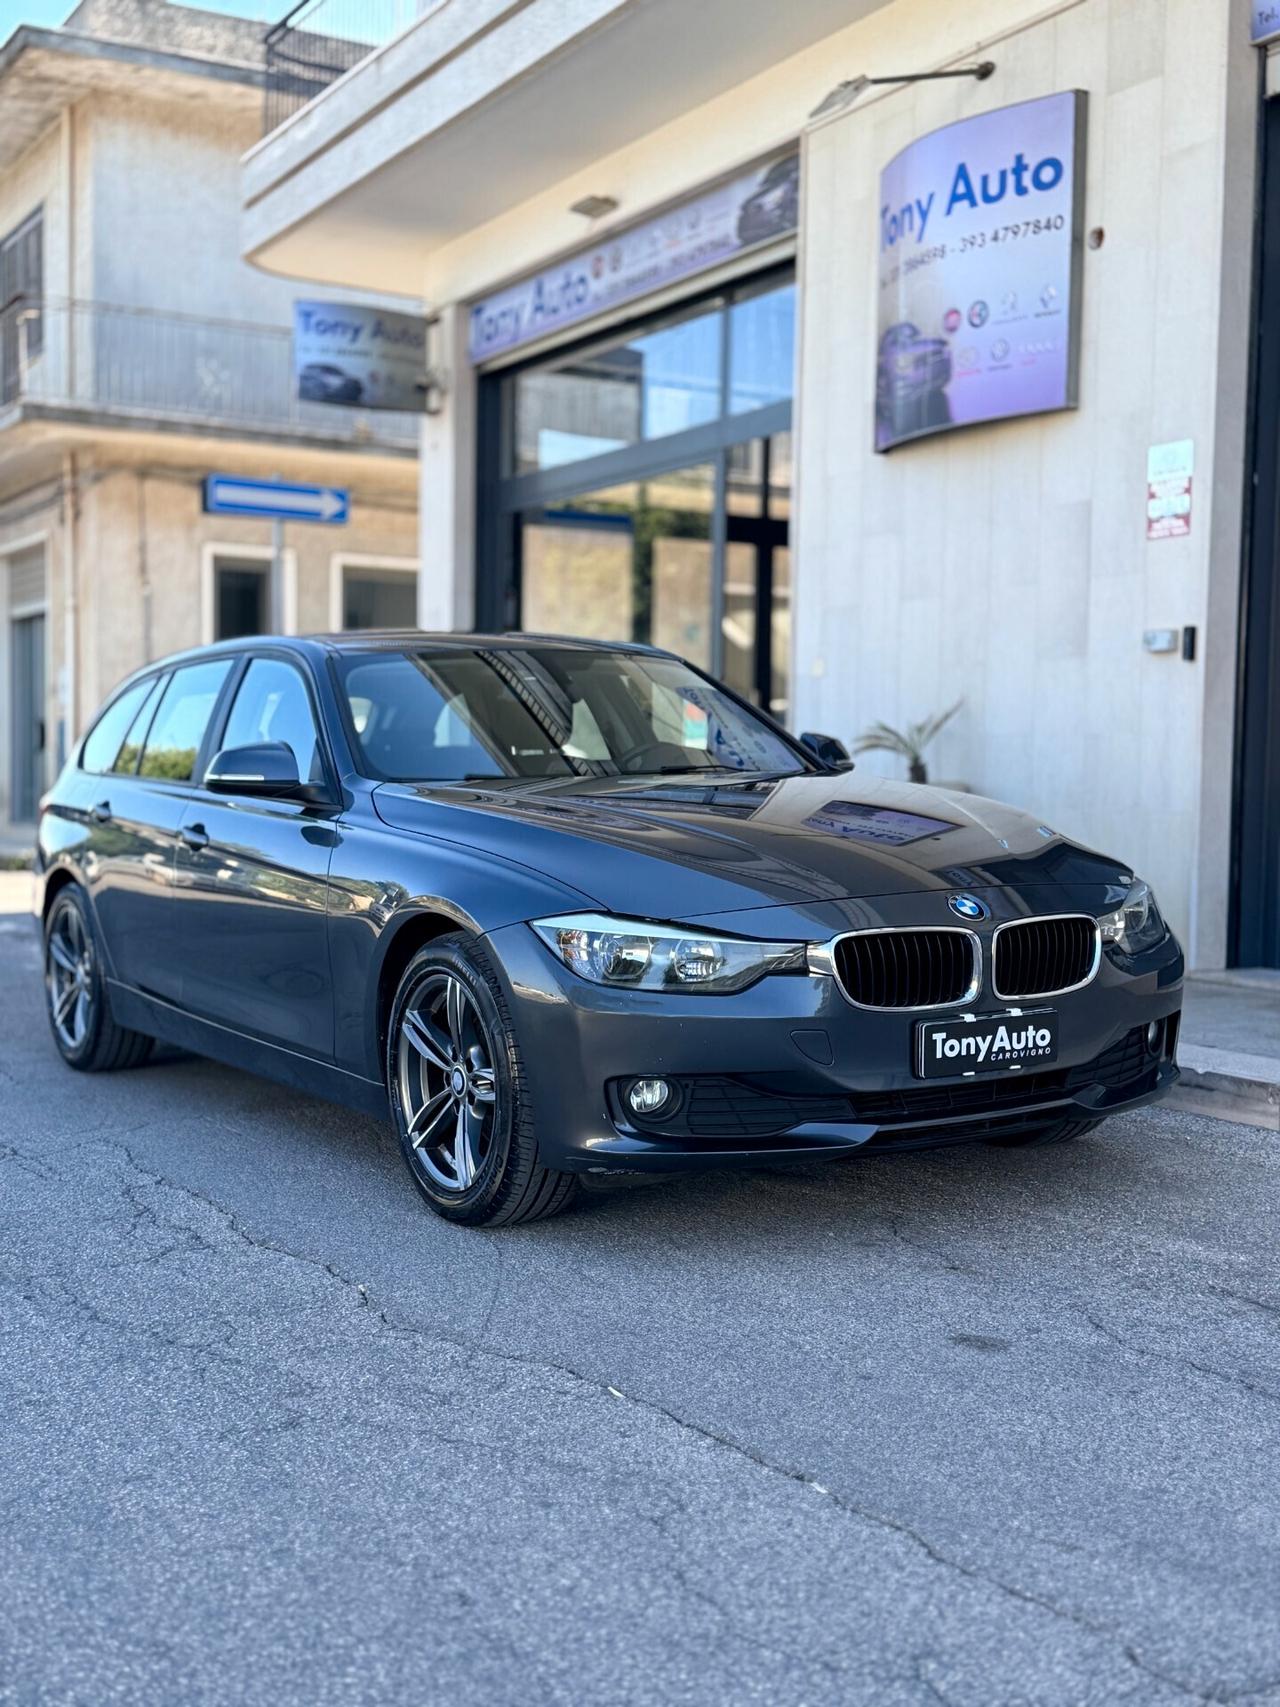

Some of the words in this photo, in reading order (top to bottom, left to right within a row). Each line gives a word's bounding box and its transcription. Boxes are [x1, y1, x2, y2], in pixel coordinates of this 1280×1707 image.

[880, 192, 934, 251] Tony
[945, 153, 1063, 216] Auto
[990, 214, 1065, 242] 4797840
[301, 309, 363, 343] Tony
[990, 1047, 1051, 1062] CAROVIGNO
